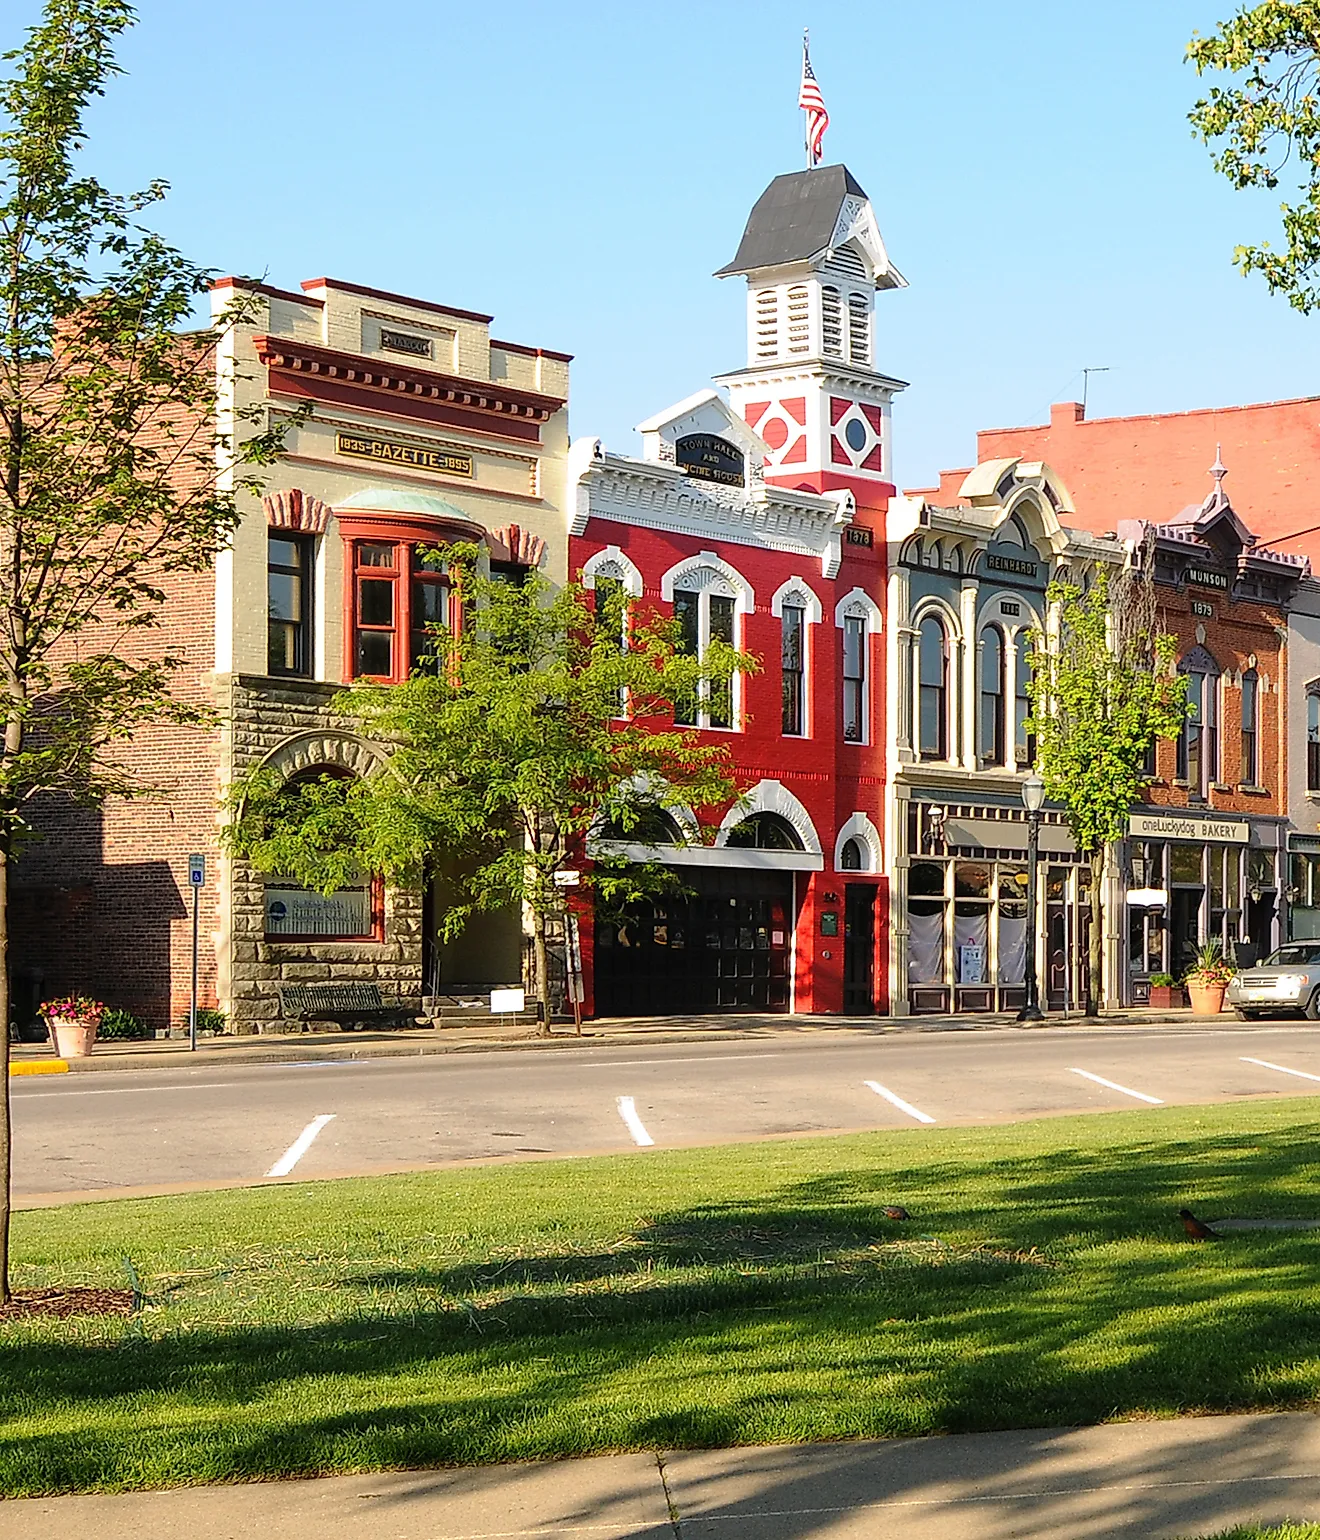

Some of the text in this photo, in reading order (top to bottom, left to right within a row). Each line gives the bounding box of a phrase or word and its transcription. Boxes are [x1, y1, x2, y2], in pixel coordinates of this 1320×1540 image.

[682, 440, 738, 460] TOWN HALL
[703, 453, 720, 464] AND
[988, 556, 1037, 576] REINHARDT
[1190, 569, 1227, 588] MUNSON
[1202, 823, 1237, 838] BAKERY
